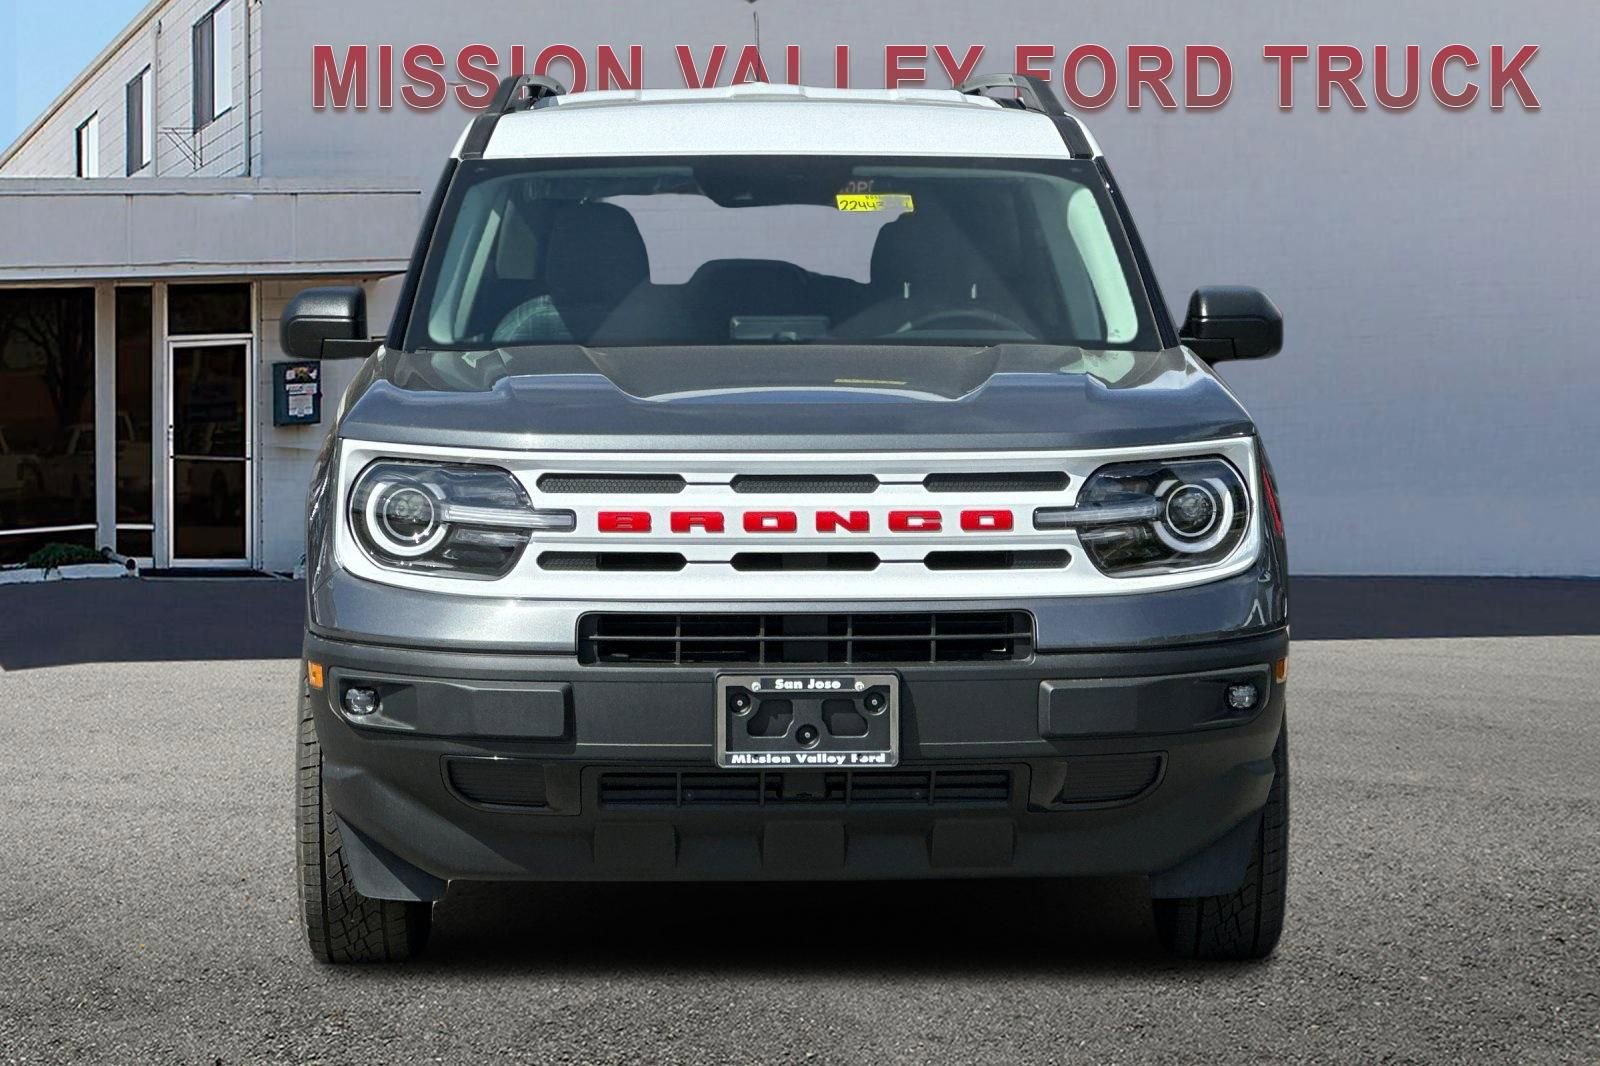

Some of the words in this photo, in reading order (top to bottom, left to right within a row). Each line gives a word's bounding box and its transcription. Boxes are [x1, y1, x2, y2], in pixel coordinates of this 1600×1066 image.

[311, 43, 643, 109] MISSION
[1014, 43, 1234, 108] FORD
[1263, 43, 1542, 109] TRUCK
[597, 509, 1014, 534] BRONCO
[775, 678, 803, 690] San
[807, 678, 842, 690] Jose
[731, 753, 791, 764] Mission
[795, 753, 846, 765] Valley
[851, 753, 886, 763] Ford
